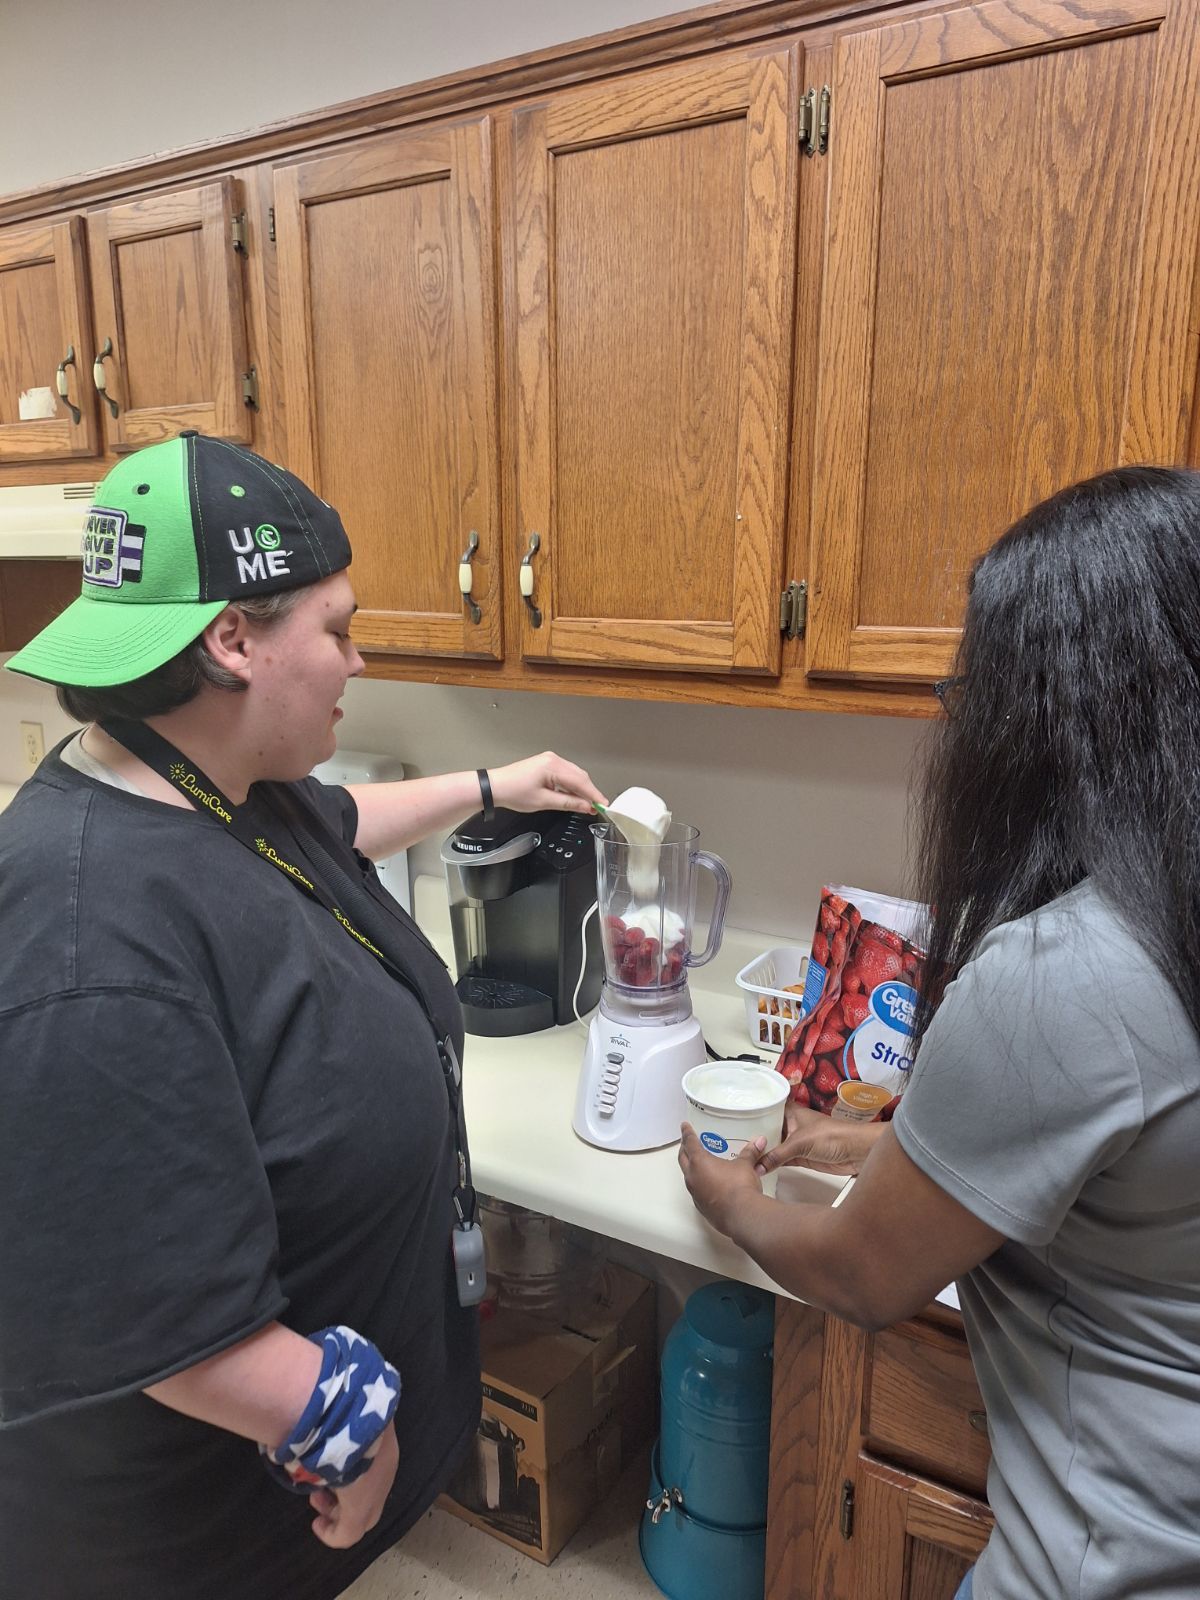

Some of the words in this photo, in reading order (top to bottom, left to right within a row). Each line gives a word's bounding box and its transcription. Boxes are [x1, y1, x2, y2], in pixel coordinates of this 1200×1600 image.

[82, 515, 117, 537] EVER
[228, 527, 255, 554] U
[84, 554, 113, 575] UP
[236, 550, 292, 584] ME
[180, 773, 233, 825] LumiCare
[457, 842, 483, 852] KEURIG
[266, 848, 316, 891] LumiCare
[341, 918, 384, 958] LumiCare
[881, 987, 916, 1016] Gre
[610, 1038, 630, 1048] RIVAL
[871, 1042, 913, 1072] Stra
[702, 1134, 723, 1147] Great
[707, 1143, 723, 1152] Value
